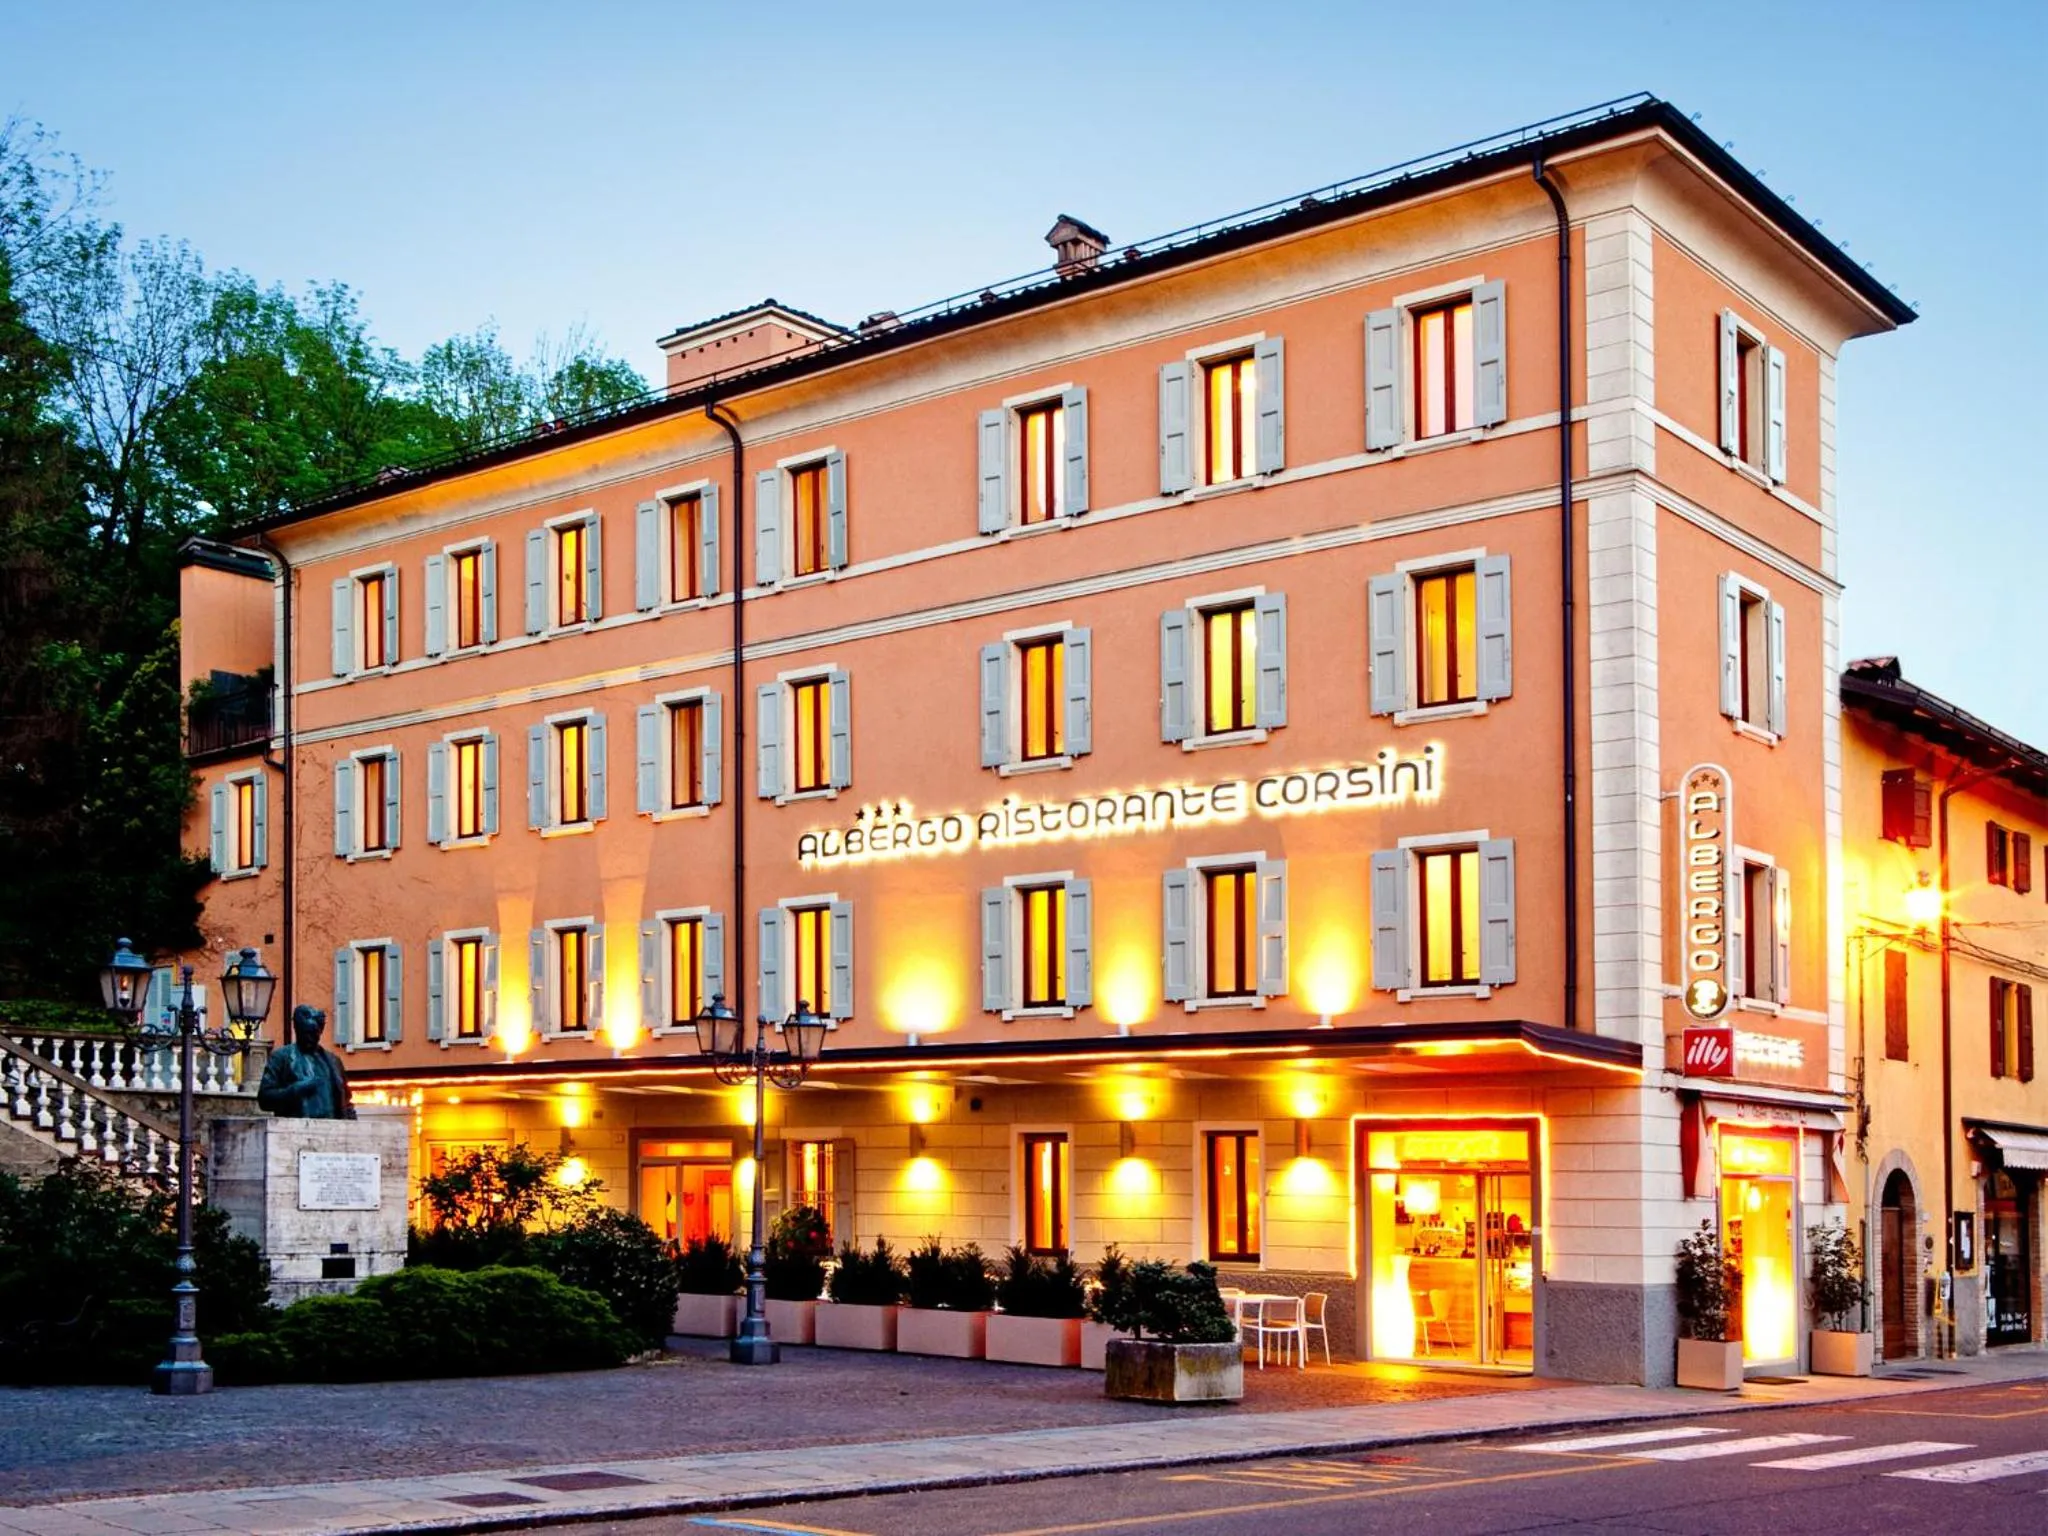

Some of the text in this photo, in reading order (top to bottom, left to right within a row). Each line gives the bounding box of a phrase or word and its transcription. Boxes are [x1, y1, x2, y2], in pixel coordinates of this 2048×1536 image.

[797, 816, 963, 861] ALBERGO
[1688, 791, 1722, 973] ALBERGO
[1686, 1035, 1729, 1072] illy
